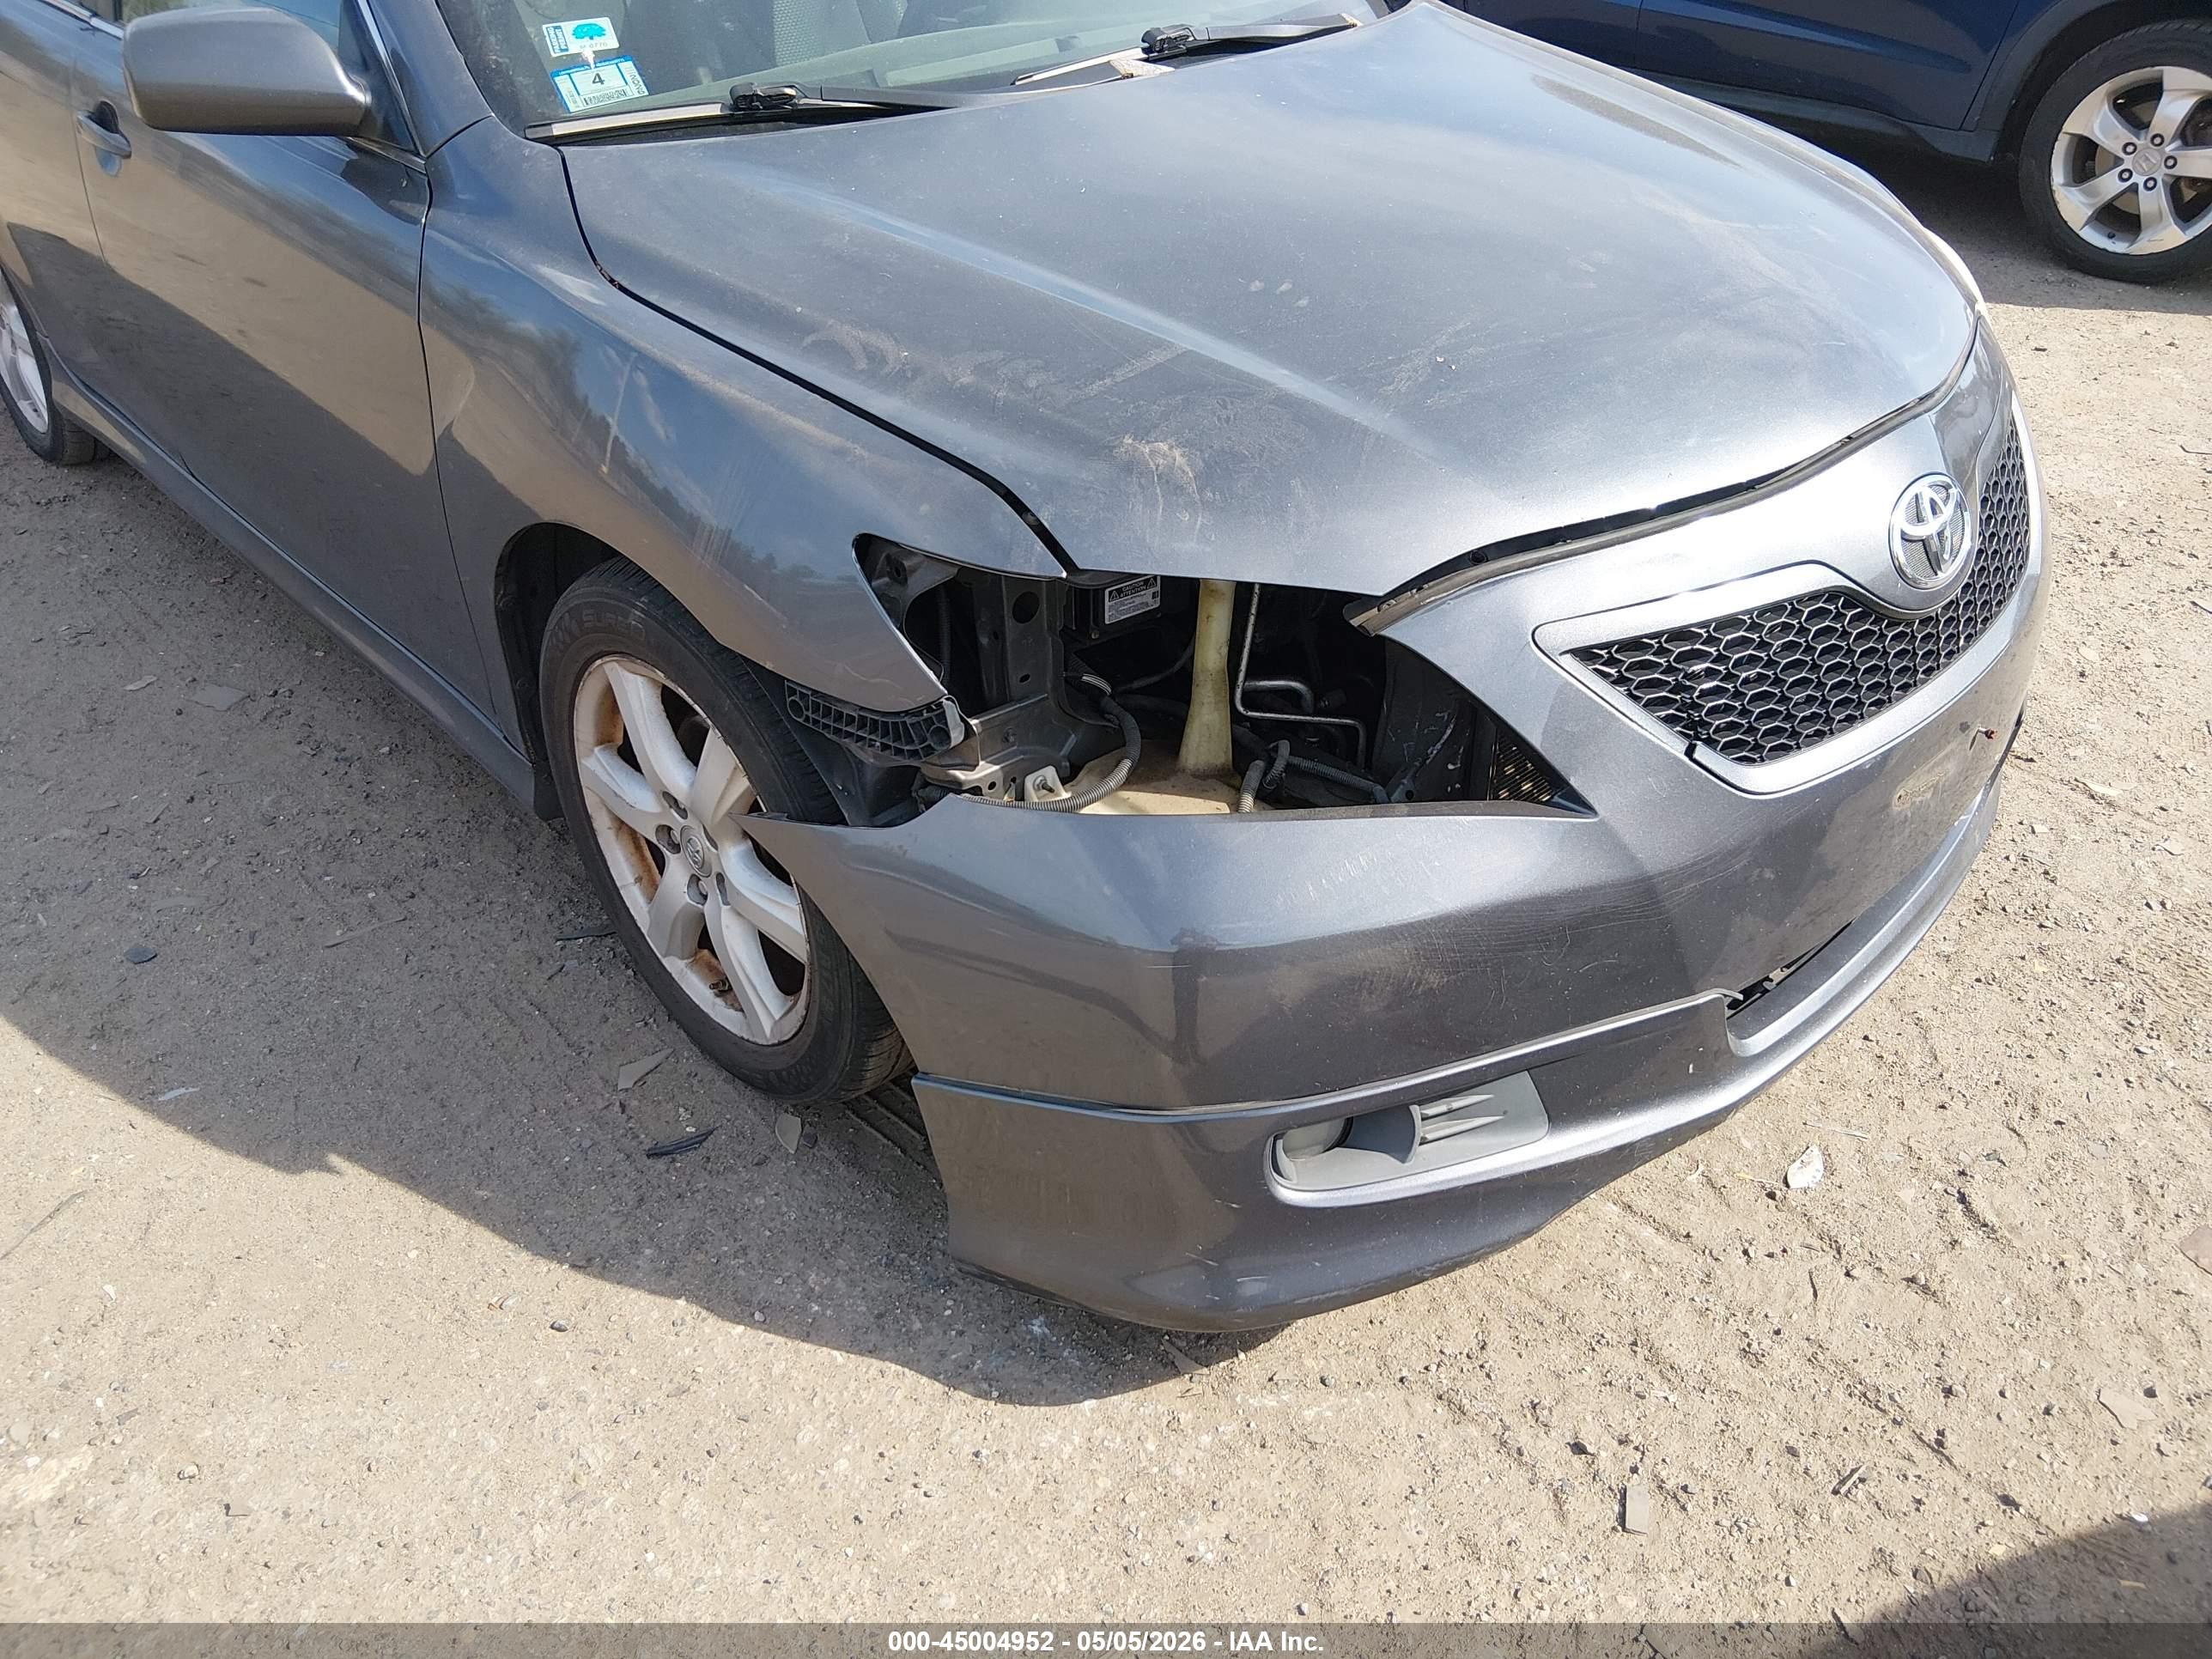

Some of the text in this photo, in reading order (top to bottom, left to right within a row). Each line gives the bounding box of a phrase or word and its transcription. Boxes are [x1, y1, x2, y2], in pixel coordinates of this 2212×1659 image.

[592, 72, 605, 85] 4
[1120, 585, 1146, 598] ATTENTION
[1122, 581, 1145, 591] CAUTION
